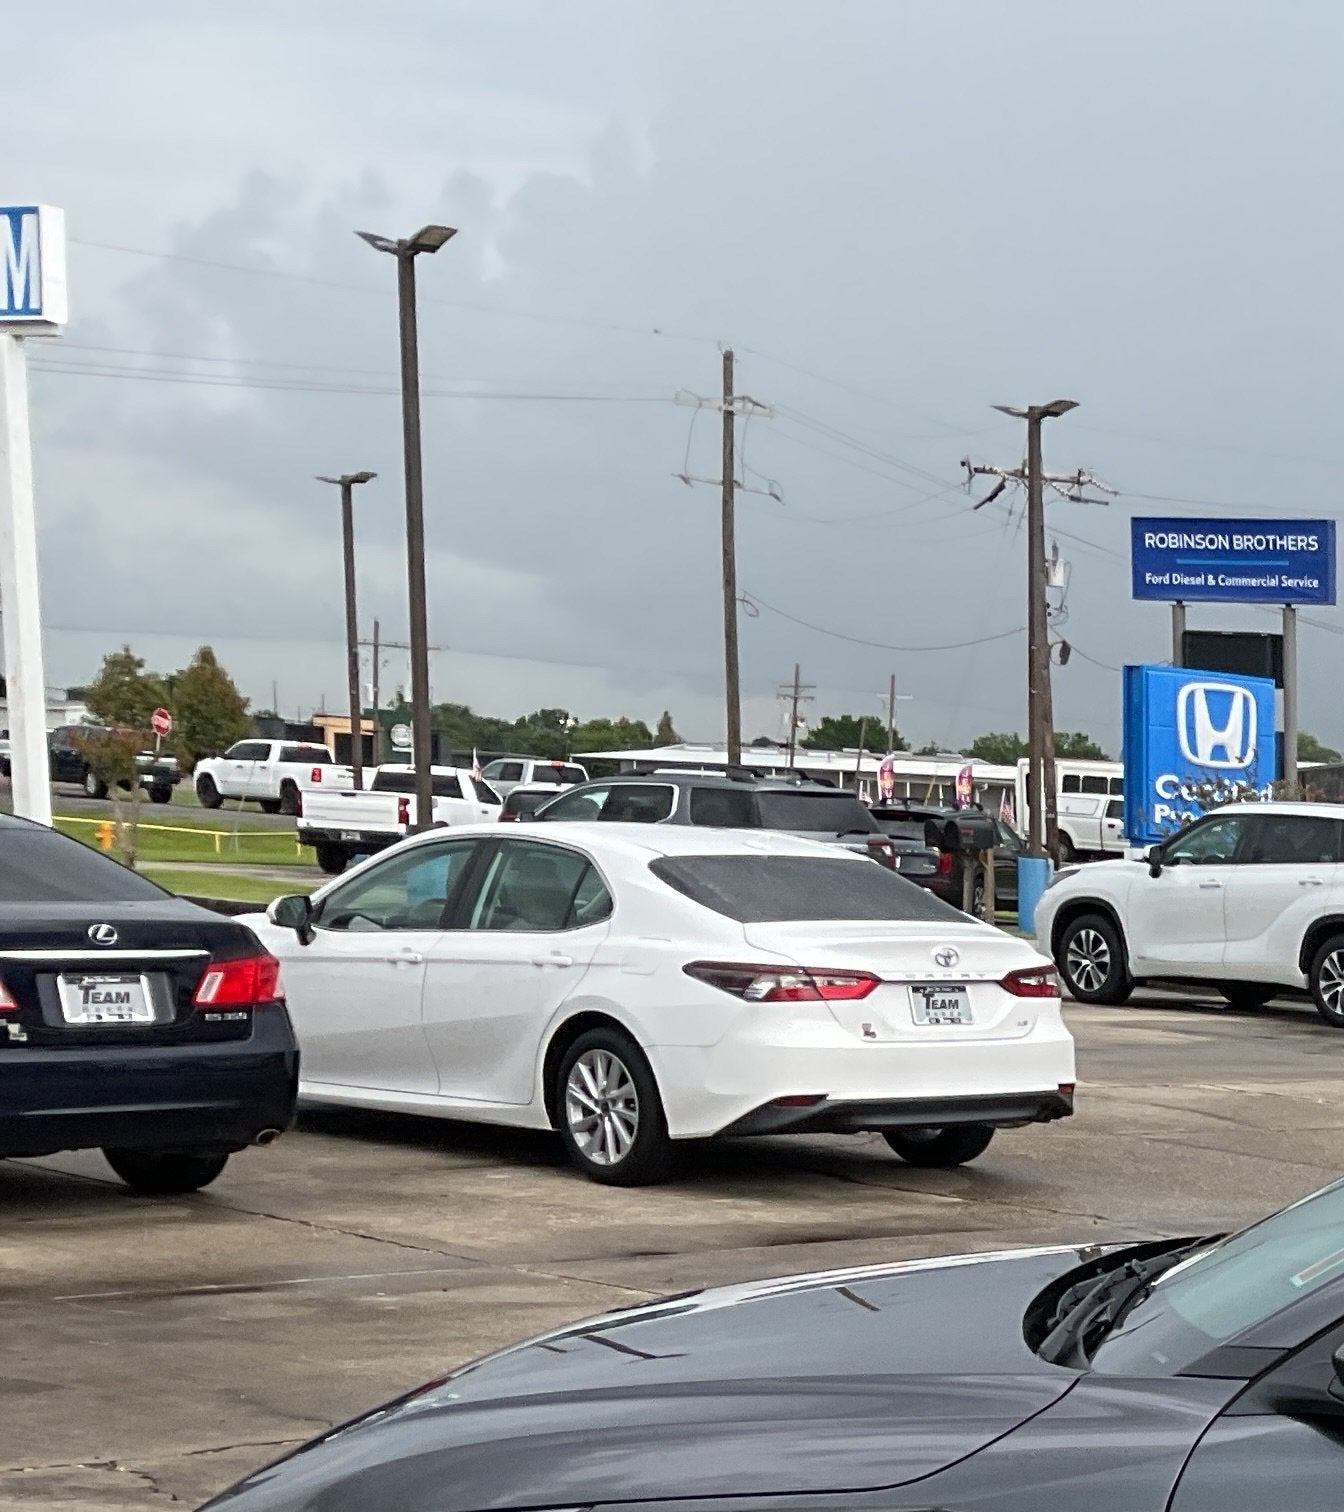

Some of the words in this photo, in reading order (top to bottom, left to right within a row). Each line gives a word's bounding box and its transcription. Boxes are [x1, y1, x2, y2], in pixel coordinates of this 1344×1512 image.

[1144, 533, 1230, 550] ROBINSON
[1232, 534, 1319, 551] BROTHERS
[1145, 572, 1170, 585] Ford
[1172, 573, 1205, 586] Diesel
[1207, 574, 1217, 586] &
[1218, 574, 1279, 587] Commercial
[1280, 575, 1319, 588] Service
